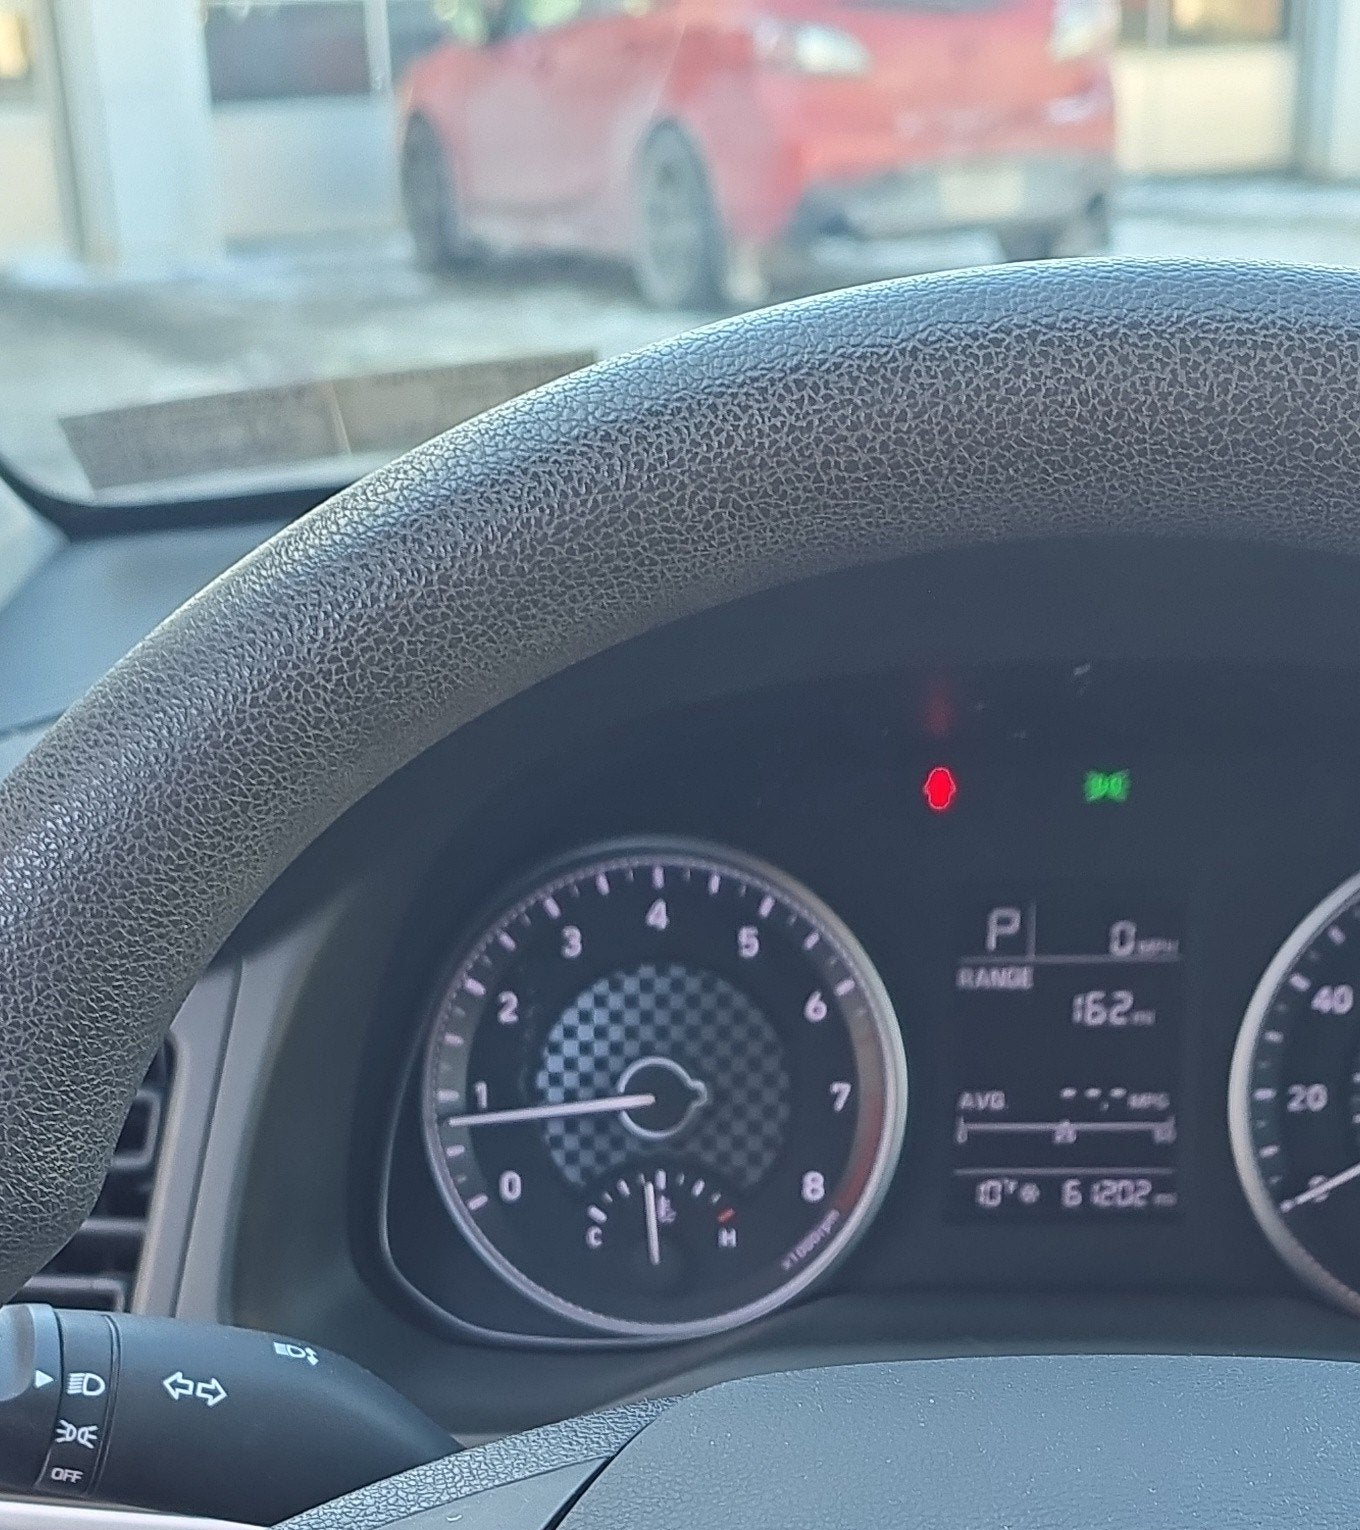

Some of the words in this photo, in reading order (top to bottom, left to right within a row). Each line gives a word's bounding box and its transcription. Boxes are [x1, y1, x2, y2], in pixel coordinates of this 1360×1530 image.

[646, 899, 668, 930] 4
[986, 907, 1021, 950] P
[561, 926, 583, 958] 3
[738, 926, 760, 958] 5
[956, 966, 1034, 990] RANGE
[499, 991, 520, 1025] 2
[805, 990, 828, 1022] 6
[1311, 984, 1354, 1015] 40
[474, 1081, 488, 1108] 1
[830, 1081, 852, 1111] 7
[1287, 1083, 1328, 1112] 20
[499, 1171, 522, 1200] 0
[802, 1171, 825, 1201] 8
[586, 1227, 604, 1248] C
[718, 1228, 737, 1248] H
[51, 1466, 84, 1484] OFF
